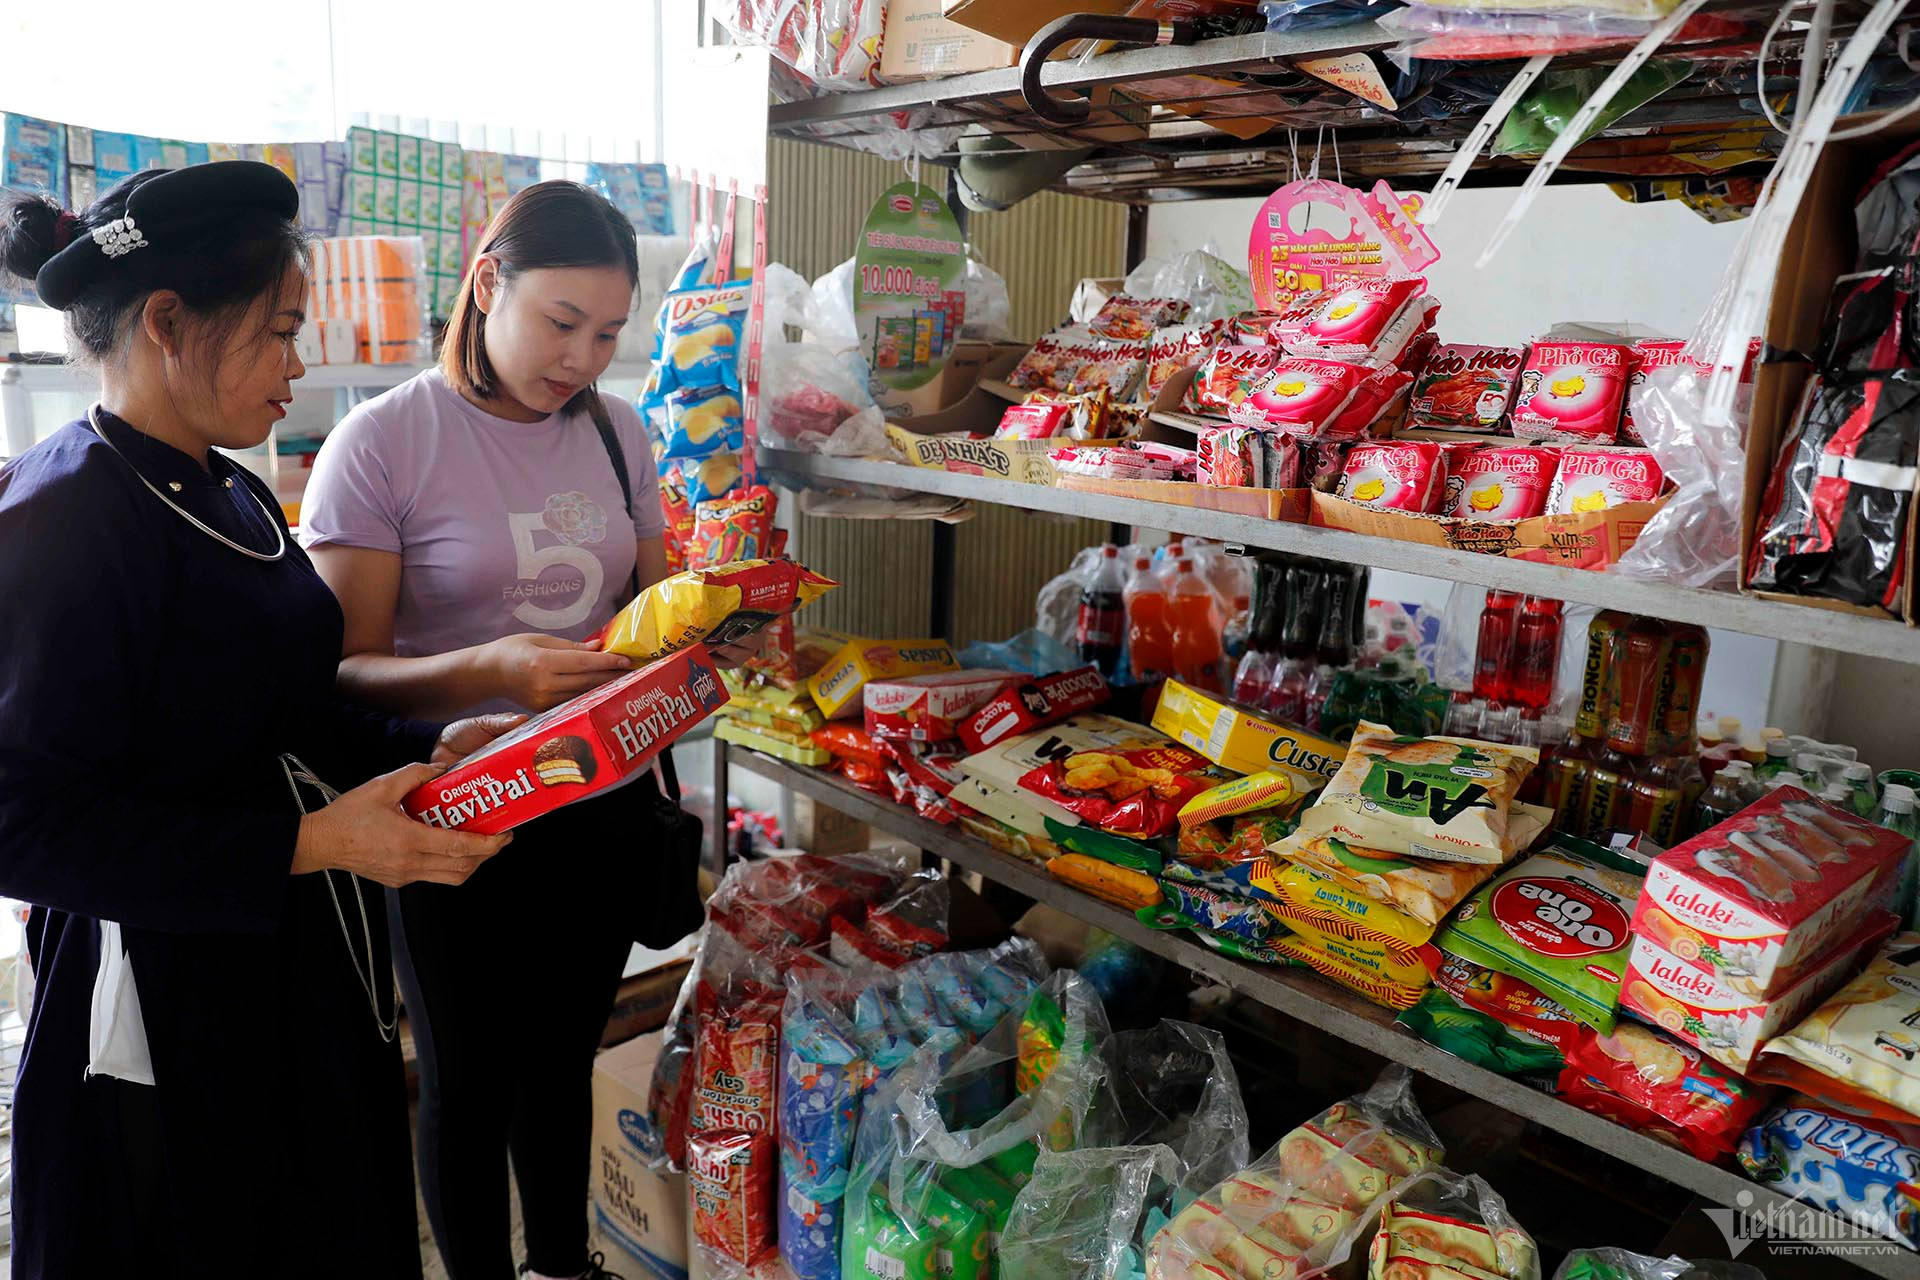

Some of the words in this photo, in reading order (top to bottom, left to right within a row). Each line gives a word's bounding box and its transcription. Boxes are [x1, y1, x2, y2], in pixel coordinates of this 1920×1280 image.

[860, 264, 914, 296] 10.000
[1273, 268, 1299, 291] 30
[1468, 347, 1522, 371] Hảo
[1537, 345, 1584, 367] Phở
[1587, 347, 1621, 367] Gà
[1461, 452, 1504, 473] Phở
[1507, 453, 1540, 474] Gà
[1562, 454, 1608, 477] Phở
[1612, 458, 1648, 482] Gà
[1551, 533, 1578, 548] KIM
[1560, 547, 1582, 560] CHI
[509, 512, 604, 630] 5
[503, 579, 581, 600] FASHIONS
[1583, 630, 1604, 714] BONCHA
[626, 685, 666, 718] ORIGINAL
[1253, 721, 1279, 736] ORION
[1268, 735, 1346, 779] Custa
[440, 772, 495, 804] ORIGINAL
[1517, 882, 1594, 922] One
[1665, 884, 1735, 924] lalaki
[1534, 905, 1616, 949] One
[1535, 929, 1563, 945] Bánh
[1326, 942, 1348, 957] Milk
[1350, 952, 1380, 970] Candy
[1649, 957, 1716, 997] lalaki
[703, 1103, 765, 1131] Oishi
